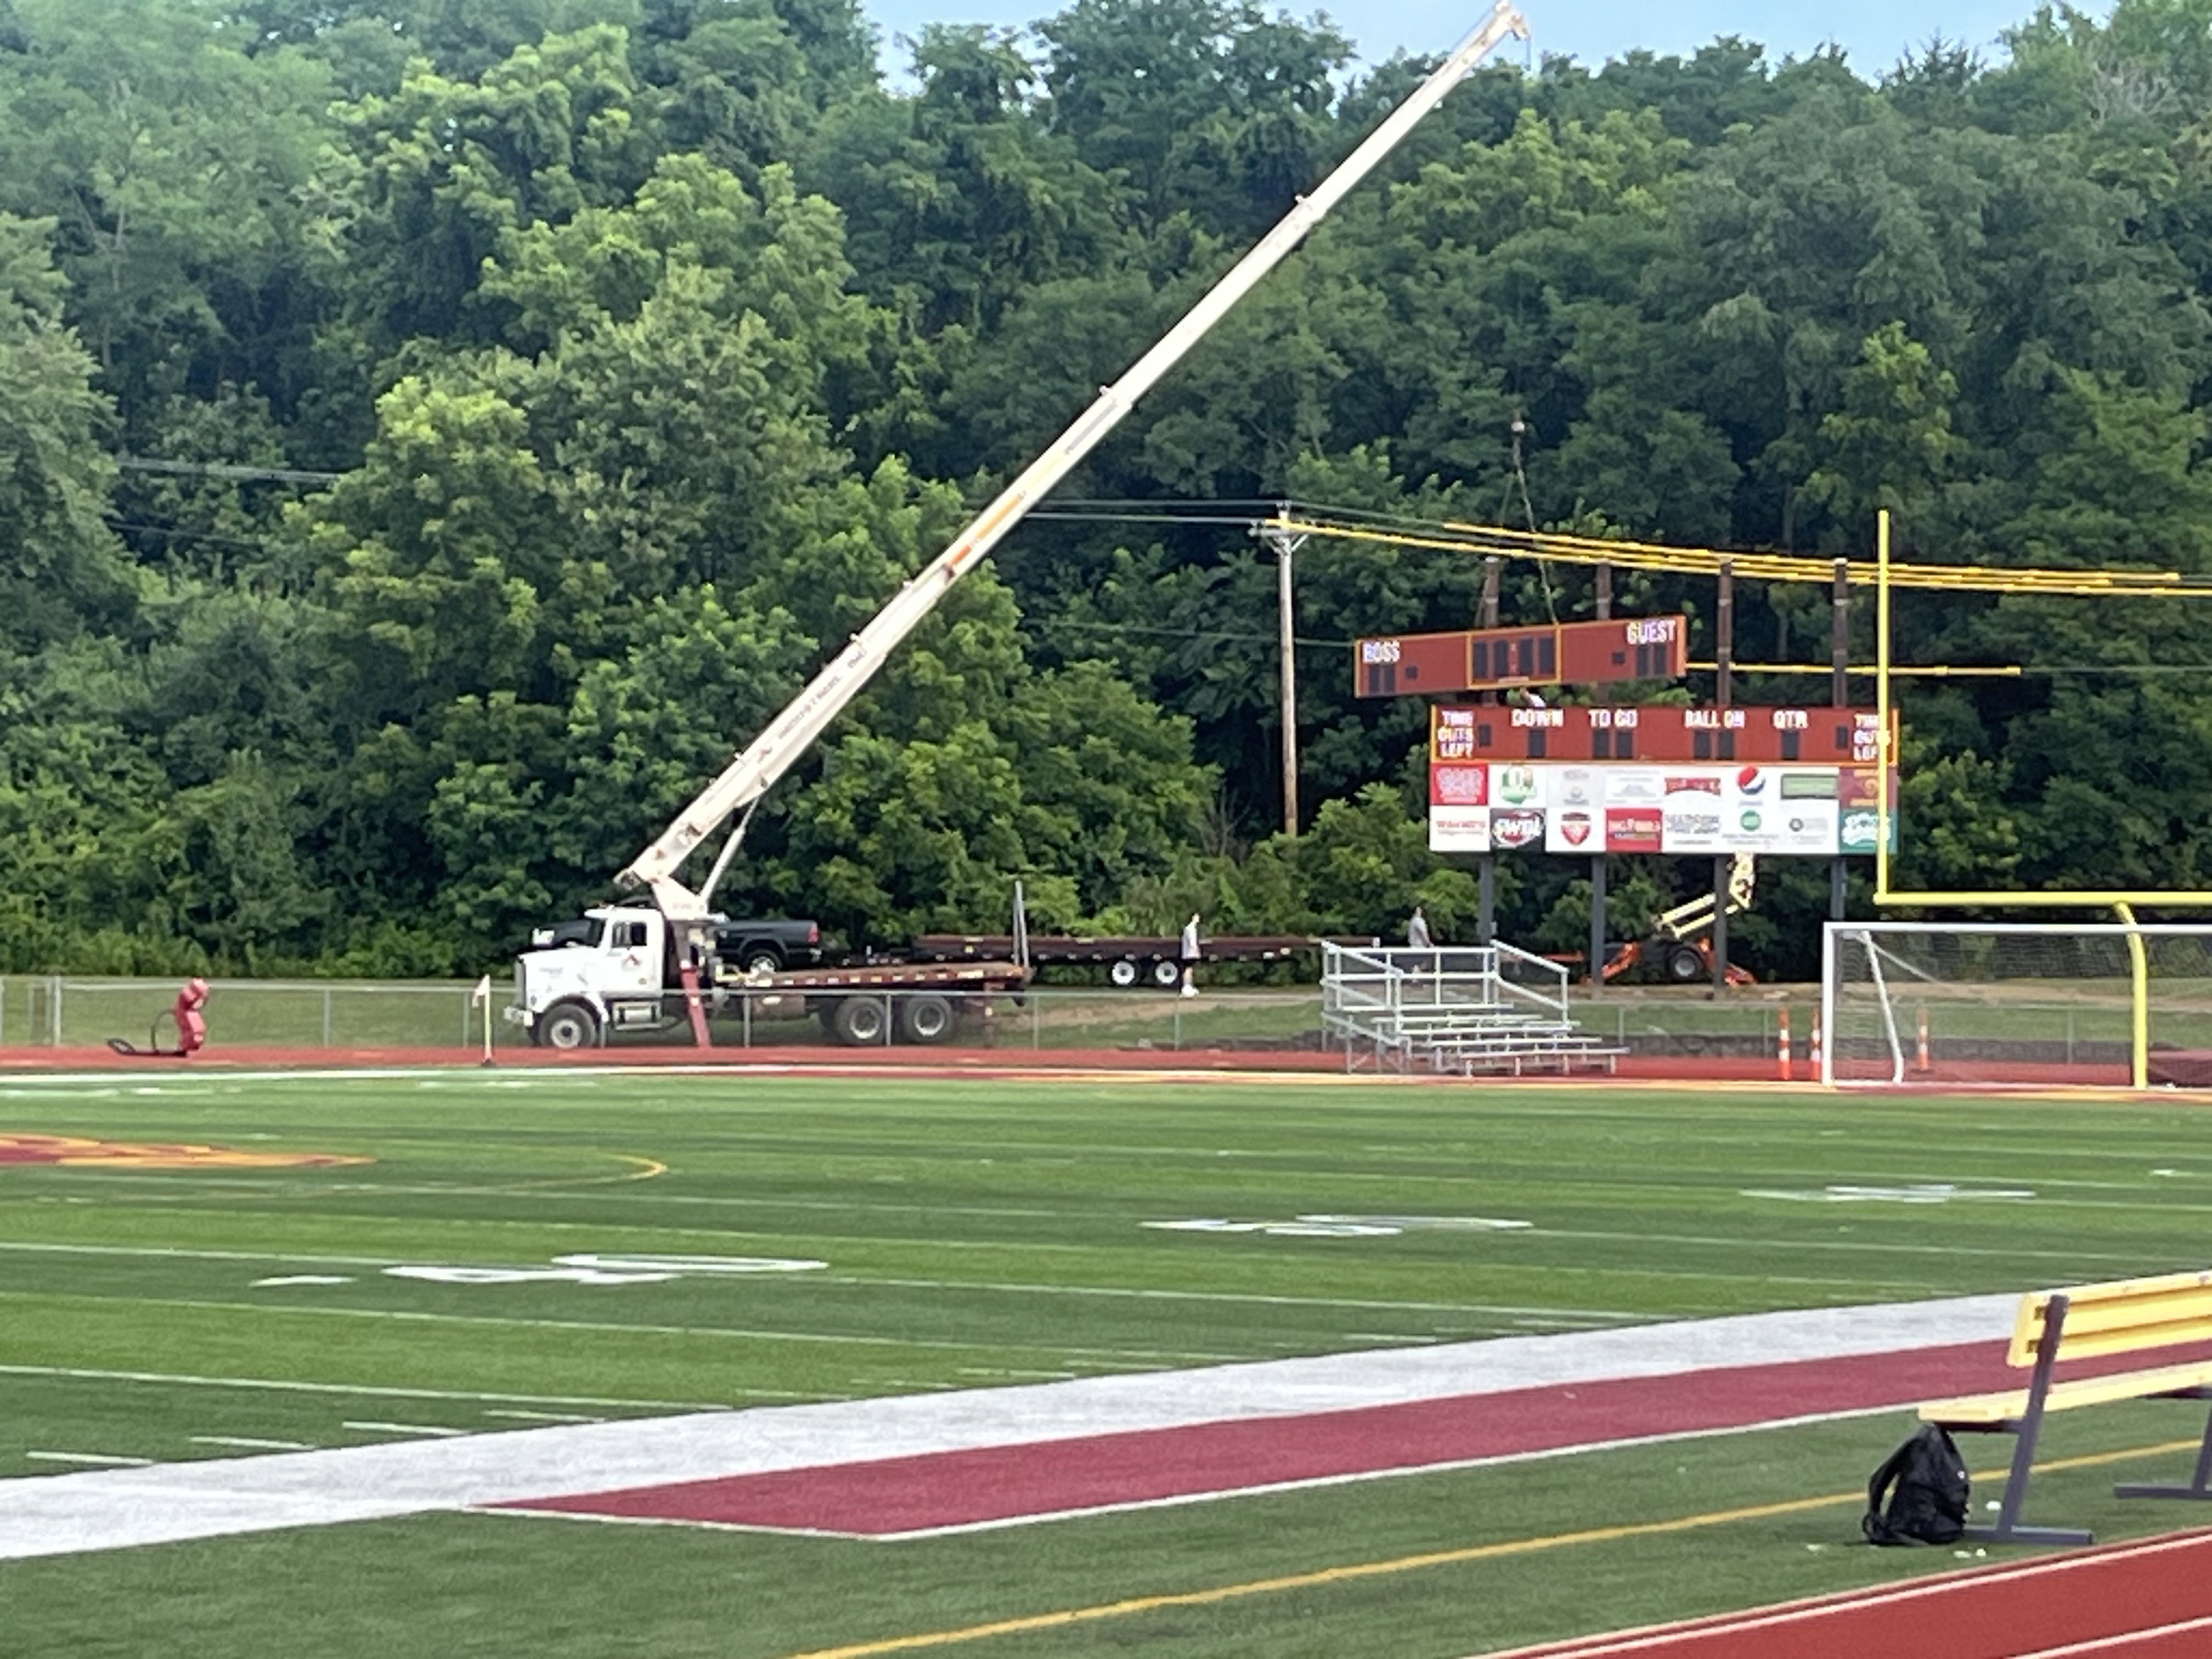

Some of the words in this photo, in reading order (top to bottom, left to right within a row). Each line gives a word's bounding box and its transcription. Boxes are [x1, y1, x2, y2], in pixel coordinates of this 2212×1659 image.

[1627, 620, 1676, 645] GUEST
[1511, 708, 1564, 727] DOWN
[1588, 709, 1611, 727] TO
[1615, 709, 1638, 727] GO
[1685, 710, 1720, 729] BALL
[1724, 710, 1745, 729] ON
[1774, 710, 1809, 729] QTR
[1854, 714, 1879, 727] TIM
[1854, 745, 1878, 761] LEF
